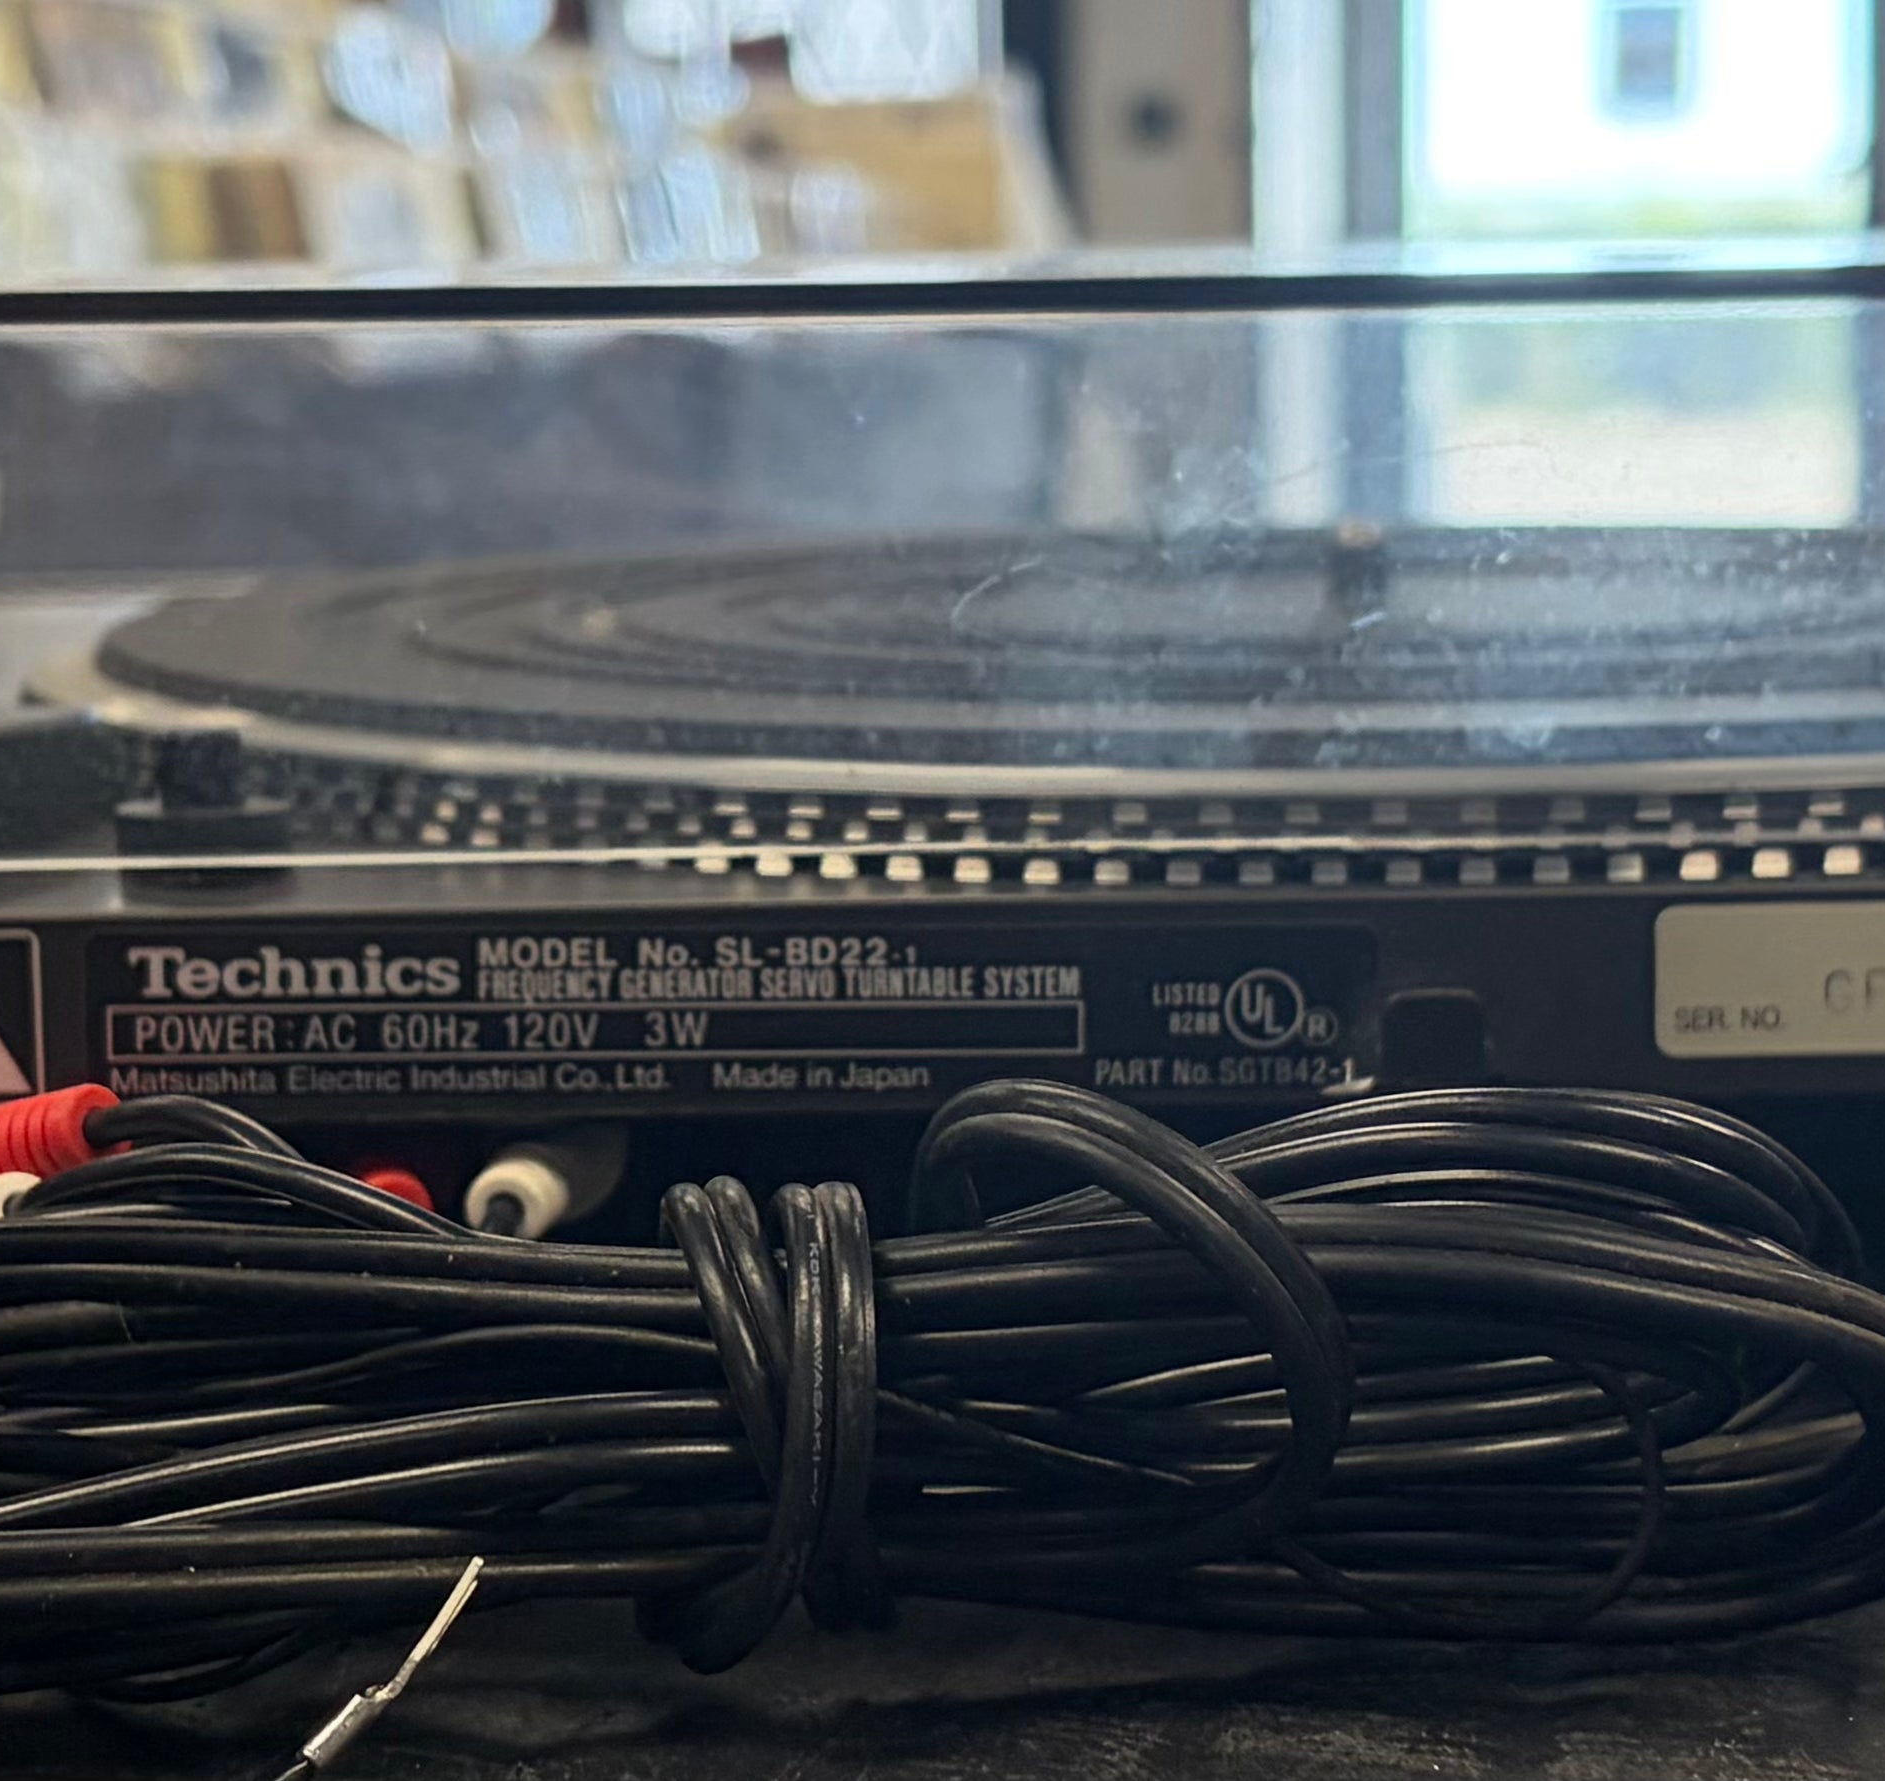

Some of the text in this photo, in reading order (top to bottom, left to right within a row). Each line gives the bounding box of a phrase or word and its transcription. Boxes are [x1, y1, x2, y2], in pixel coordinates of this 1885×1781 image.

[478, 936, 616, 967] MODEL
[638, 937, 698, 967] No.
[128, 946, 459, 998] Technics
[478, 966, 1080, 1001] FREQUENCY GENERATOR SERVO TURNTABLE SYSTEM
[1152, 982, 1221, 1007] LISTED
[1240, 983, 1284, 1035] UL
[304, 1015, 357, 1052] AC
[381, 1013, 479, 1051] 60Hz
[505, 1013, 599, 1050] 120V
[645, 1012, 710, 1049] 3W
[110, 1065, 277, 1095] Matsushita
[288, 1063, 402, 1093] Electric
[412, 1062, 545, 1091] Industrial
[714, 1062, 929, 1092] Made in Japan
[1095, 1057, 1164, 1086] PART
[1172, 1057, 1213, 1086] No.
